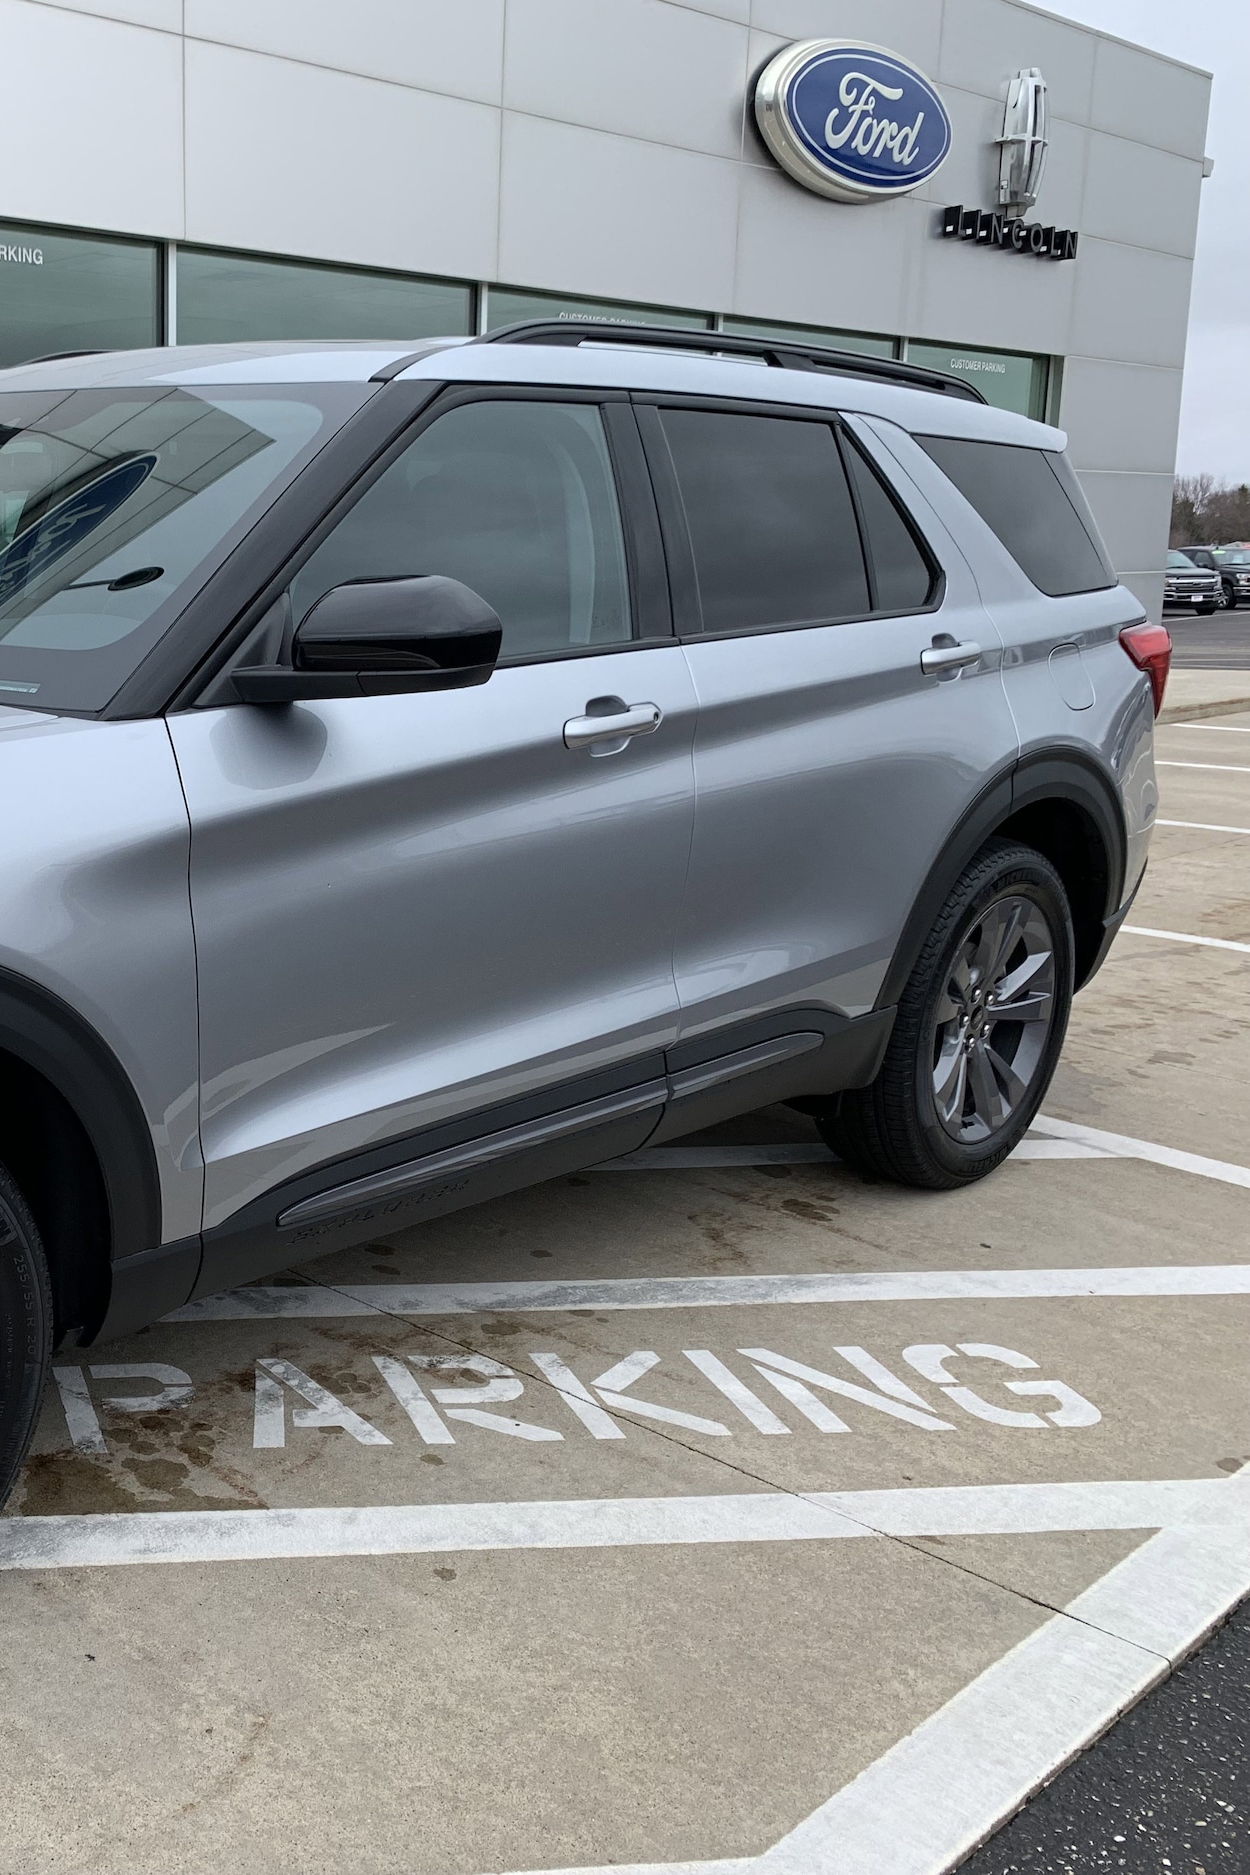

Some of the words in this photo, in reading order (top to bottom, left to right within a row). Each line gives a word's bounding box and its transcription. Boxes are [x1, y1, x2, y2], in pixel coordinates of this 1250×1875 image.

[825, 72, 925, 166] Ford
[943, 204, 1078, 260] LINCOLN
[950, 357, 982, 371] CUSTOMER
[981, 361, 1006, 374] PARKING
[13, 1254, 37, 1311] 255/55
[26, 1316, 37, 1327] R
[26, 1335, 37, 1356] 20
[51, 1343, 1103, 1453] PARKING
